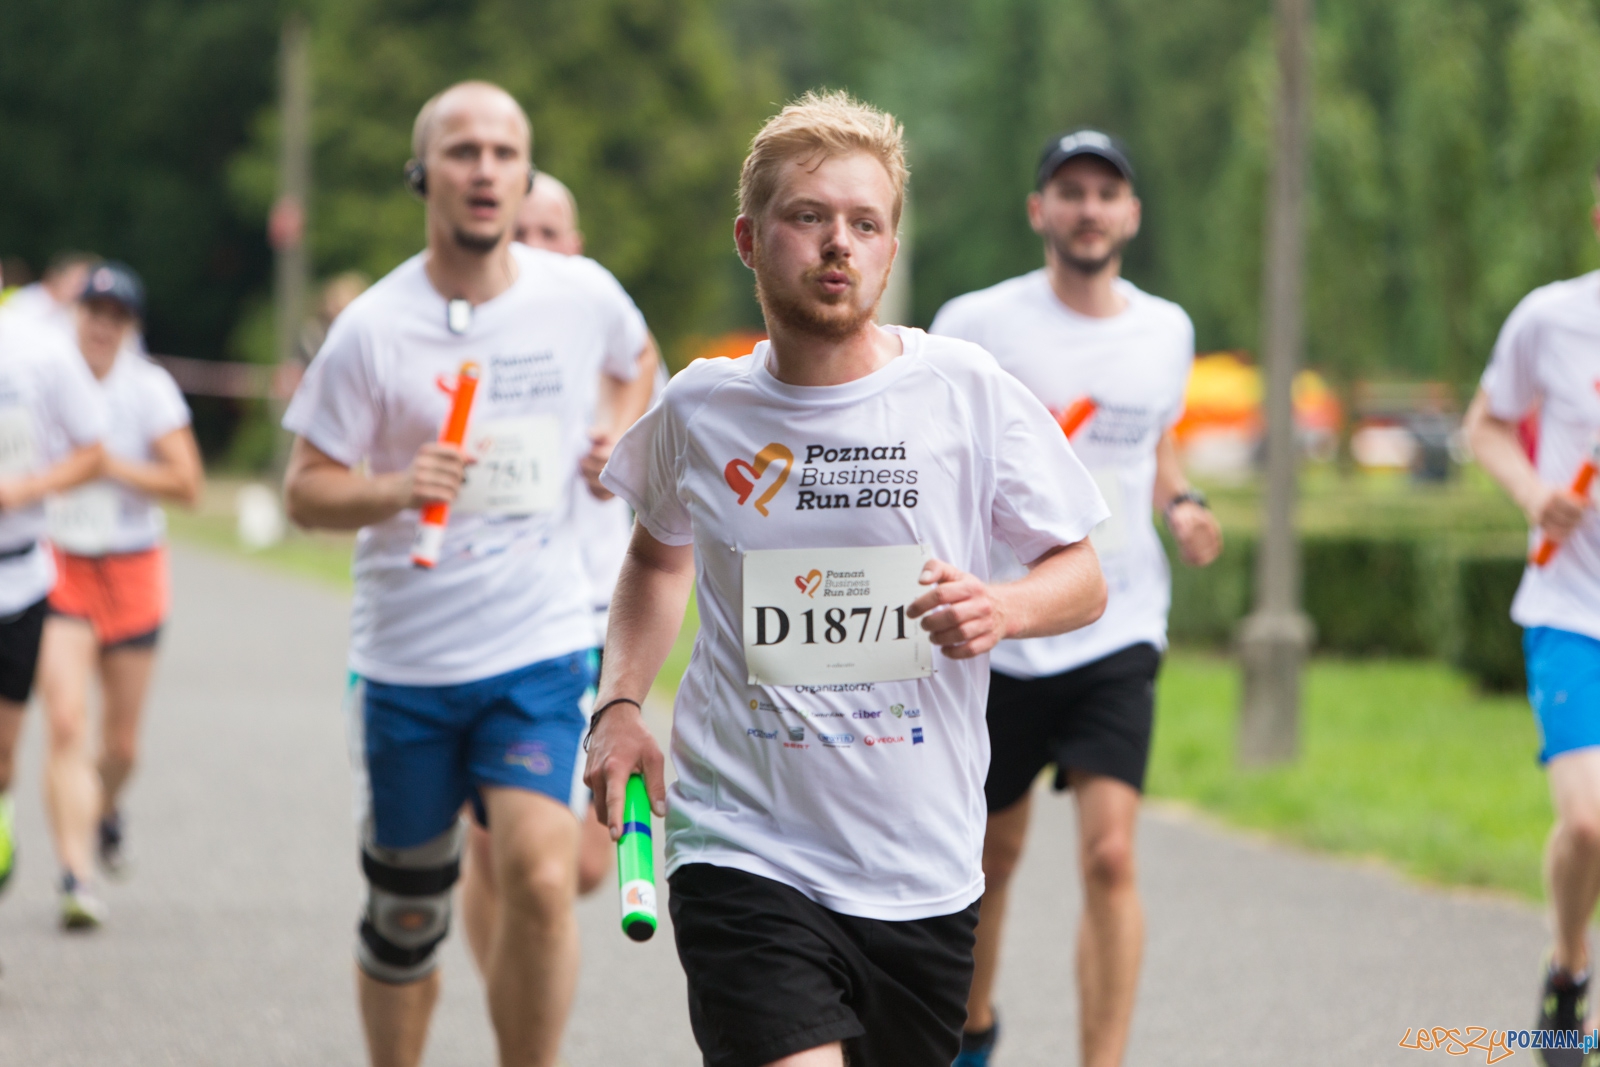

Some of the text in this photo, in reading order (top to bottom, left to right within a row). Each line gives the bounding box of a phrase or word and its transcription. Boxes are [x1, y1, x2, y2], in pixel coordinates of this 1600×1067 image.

[804, 441, 906, 464] Poznań
[799, 465, 918, 487] Business
[796, 488, 919, 510] Run 2016
[826, 569, 865, 579] Poznań
[824, 579, 870, 588] Business
[823, 587, 870, 598] Run 2016
[752, 606, 790, 646] D
[800, 605, 909, 645] 187/1
[852, 709, 883, 719] ciber
